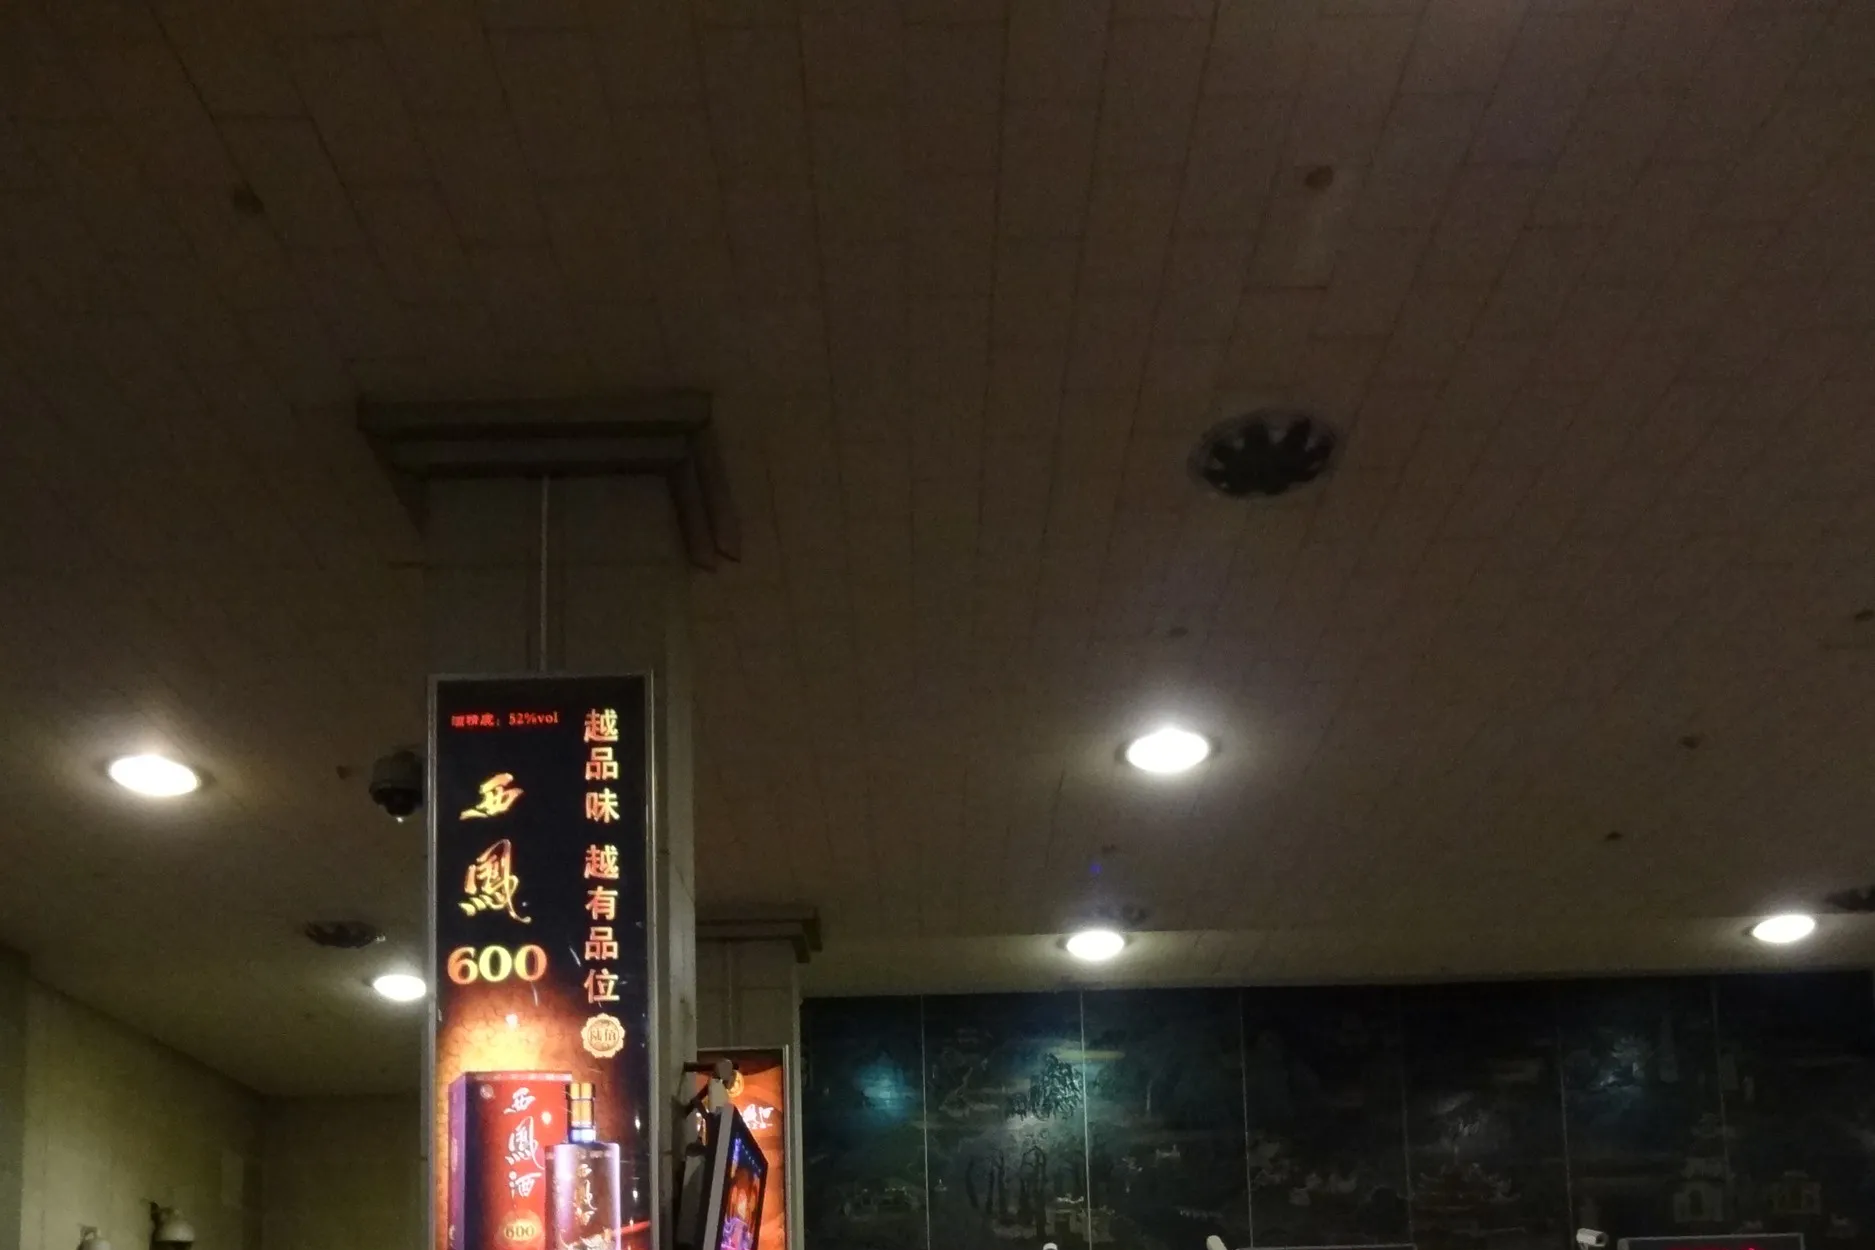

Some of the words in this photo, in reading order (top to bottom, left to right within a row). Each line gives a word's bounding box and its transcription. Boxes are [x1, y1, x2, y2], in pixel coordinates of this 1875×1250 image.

[583, 709, 619, 823] 越品味
[447, 945, 547, 985] 600
[584, 845, 620, 1003] 越有品位
